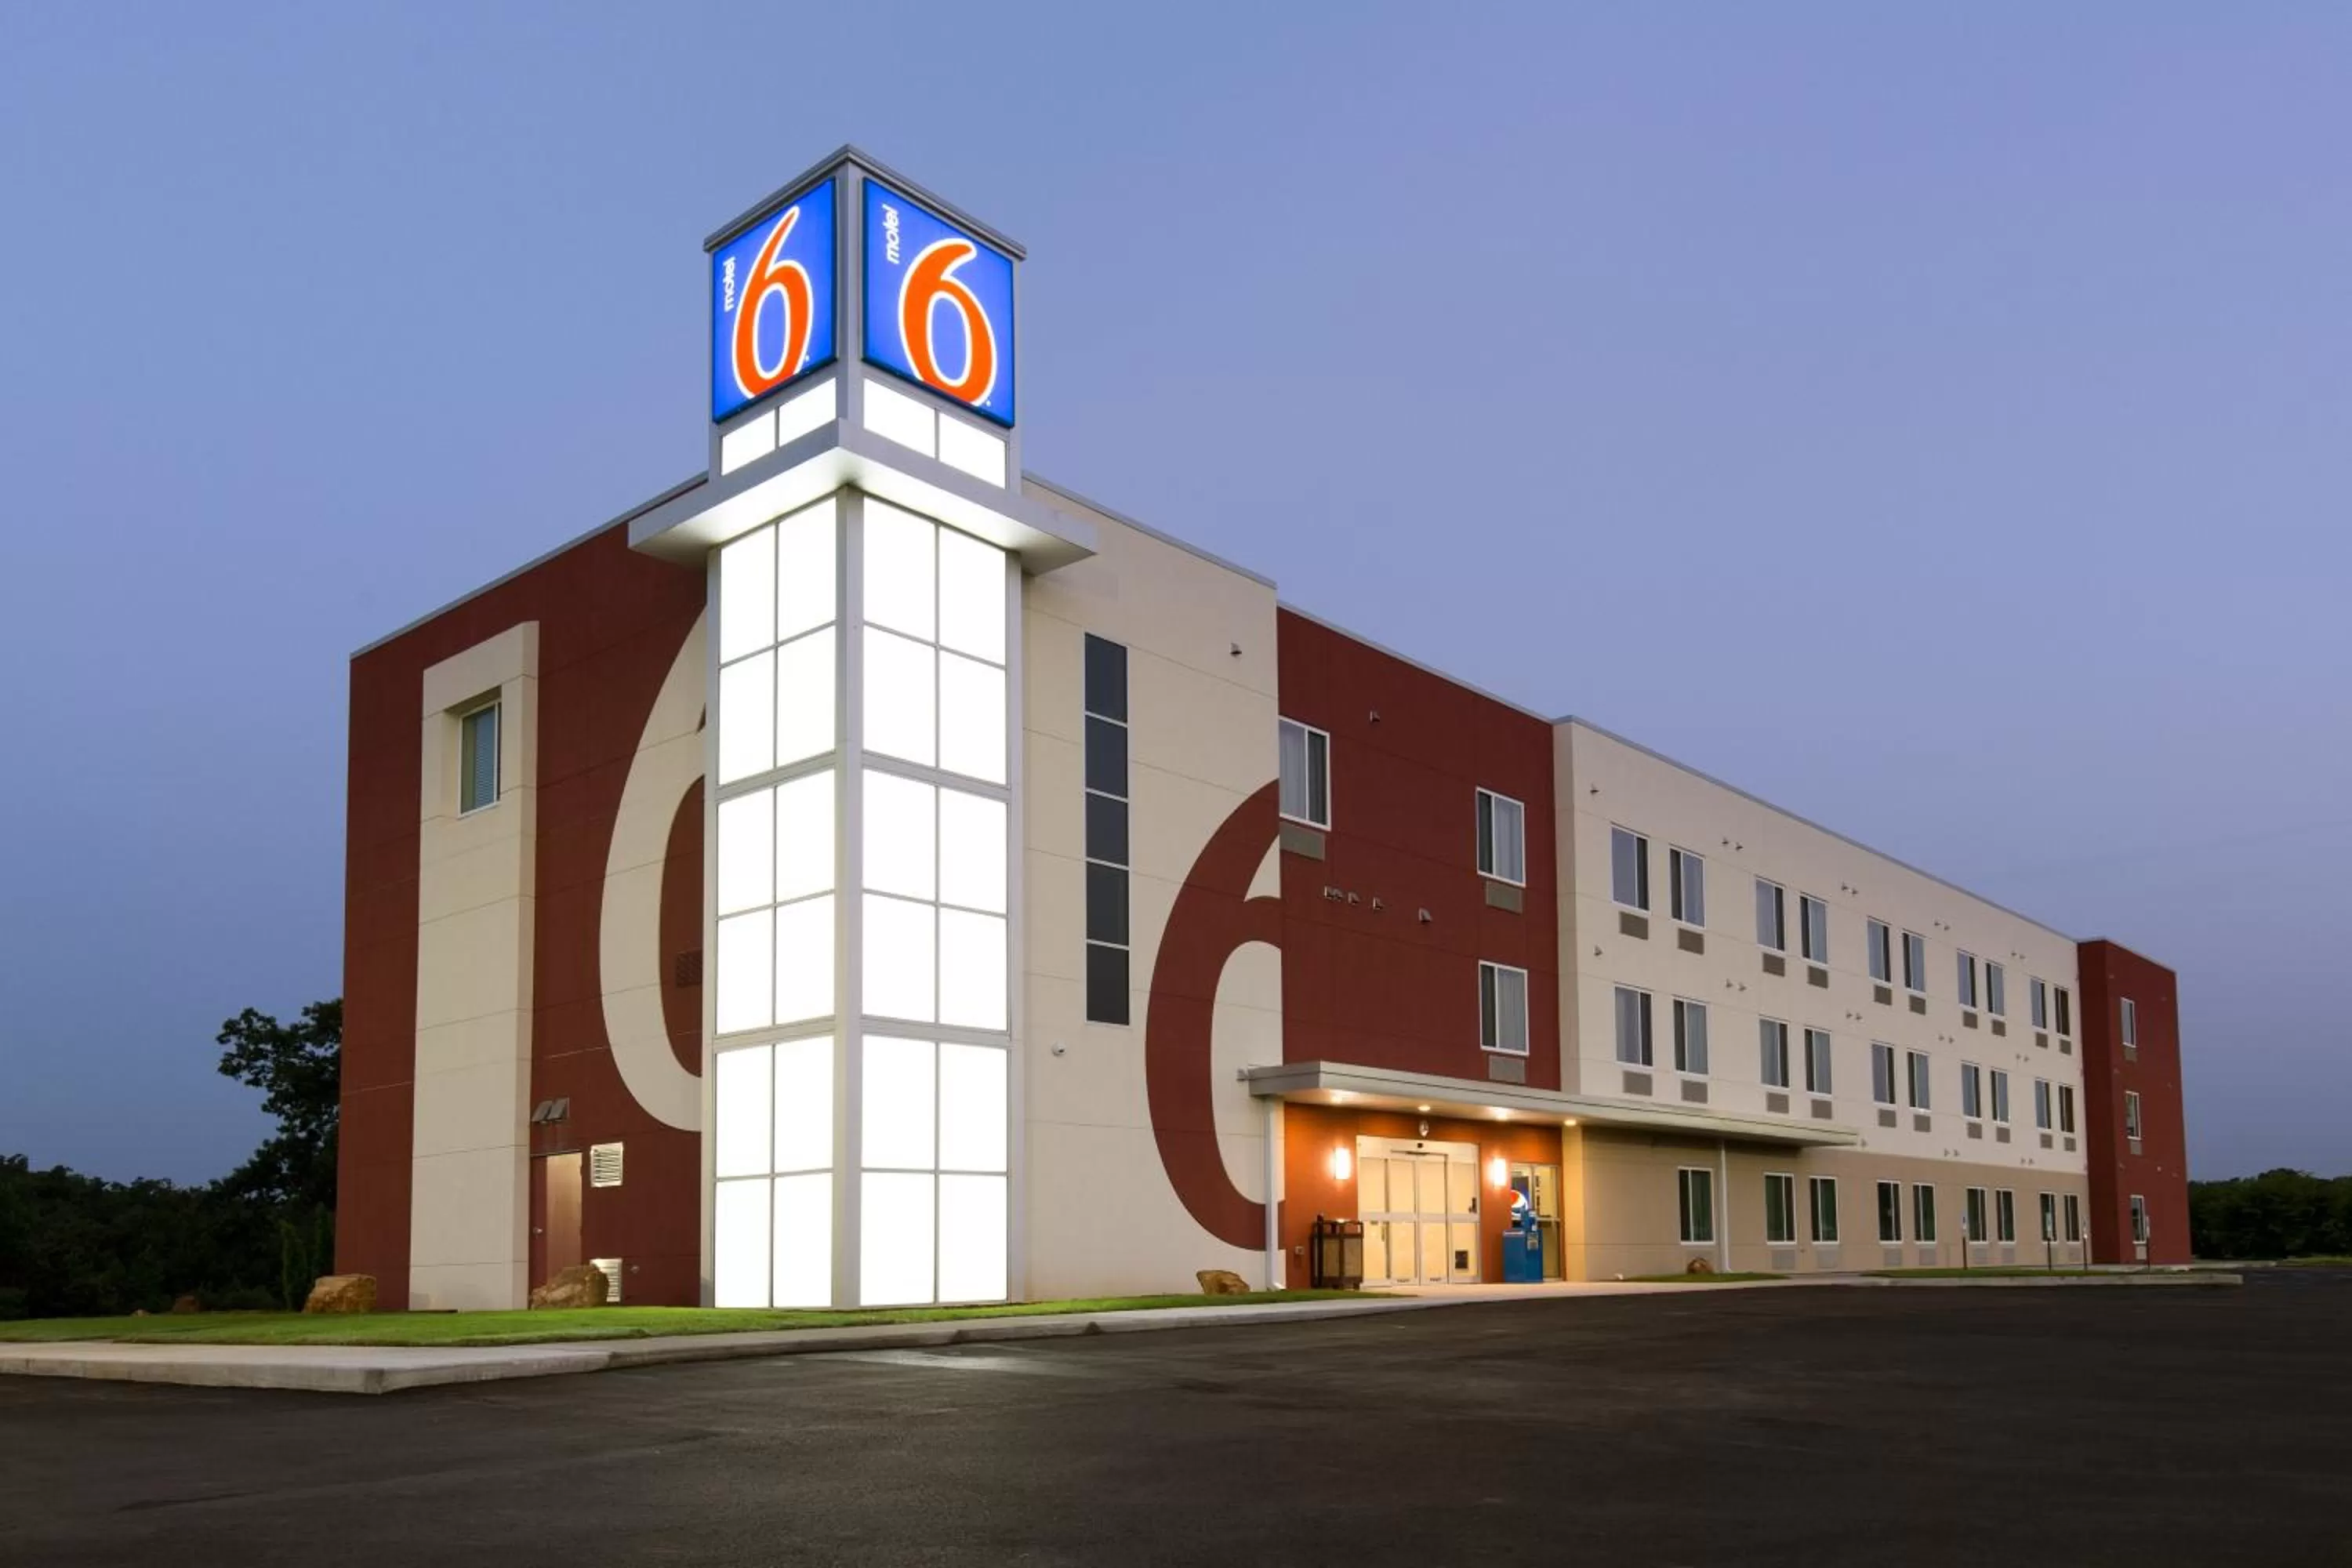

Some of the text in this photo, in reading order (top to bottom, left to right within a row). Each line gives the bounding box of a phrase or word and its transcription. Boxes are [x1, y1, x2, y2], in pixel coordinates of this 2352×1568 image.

[723, 205, 814, 398] motel 6
[882, 204, 997, 406] motel 6
